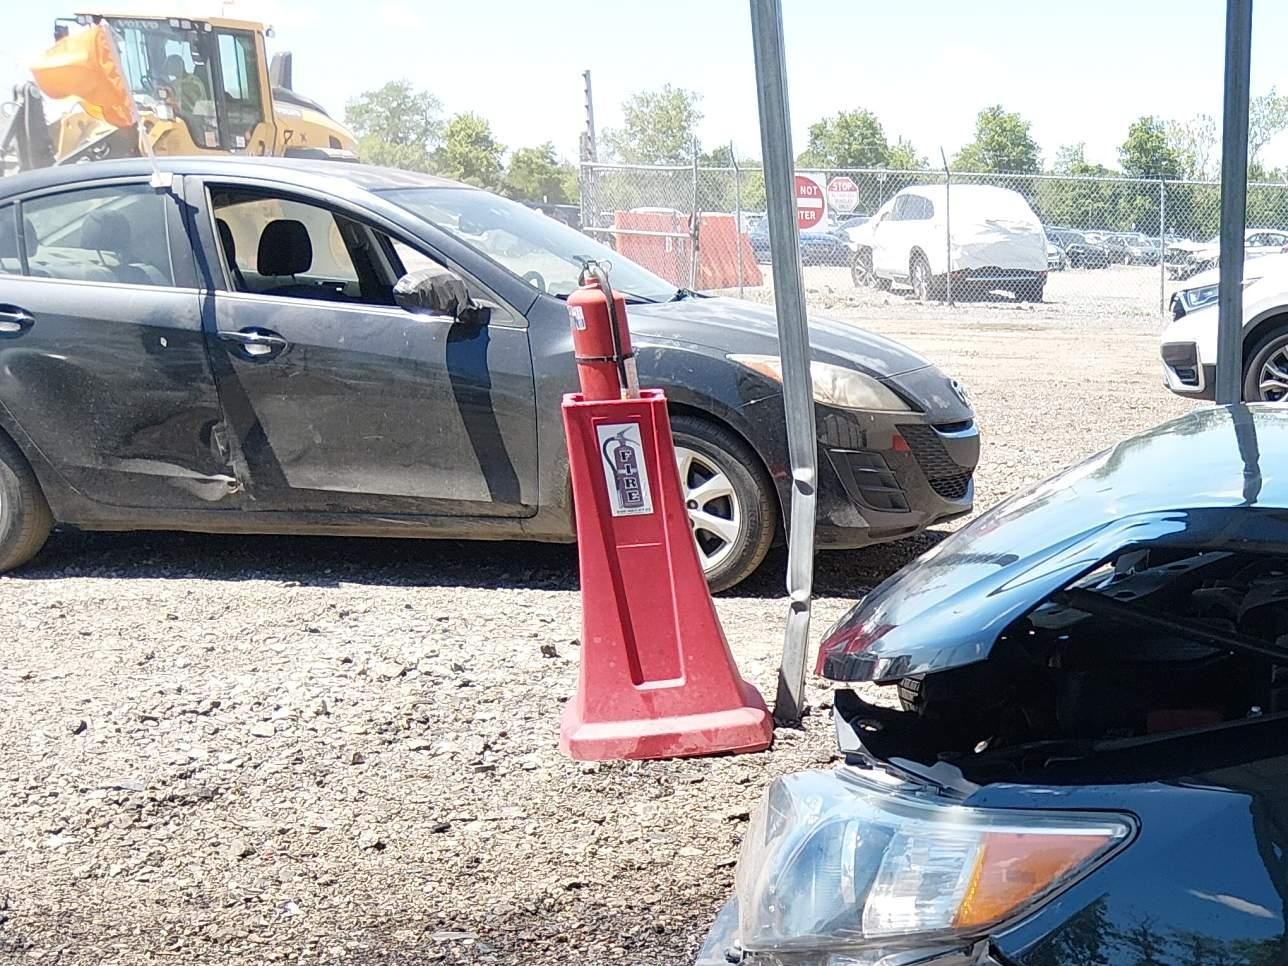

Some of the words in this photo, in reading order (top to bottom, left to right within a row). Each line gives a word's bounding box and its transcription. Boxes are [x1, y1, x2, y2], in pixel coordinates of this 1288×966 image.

[800, 185, 817, 195] NOT
[831, 182, 852, 191] STOP
[619, 450, 641, 502] FIRE
